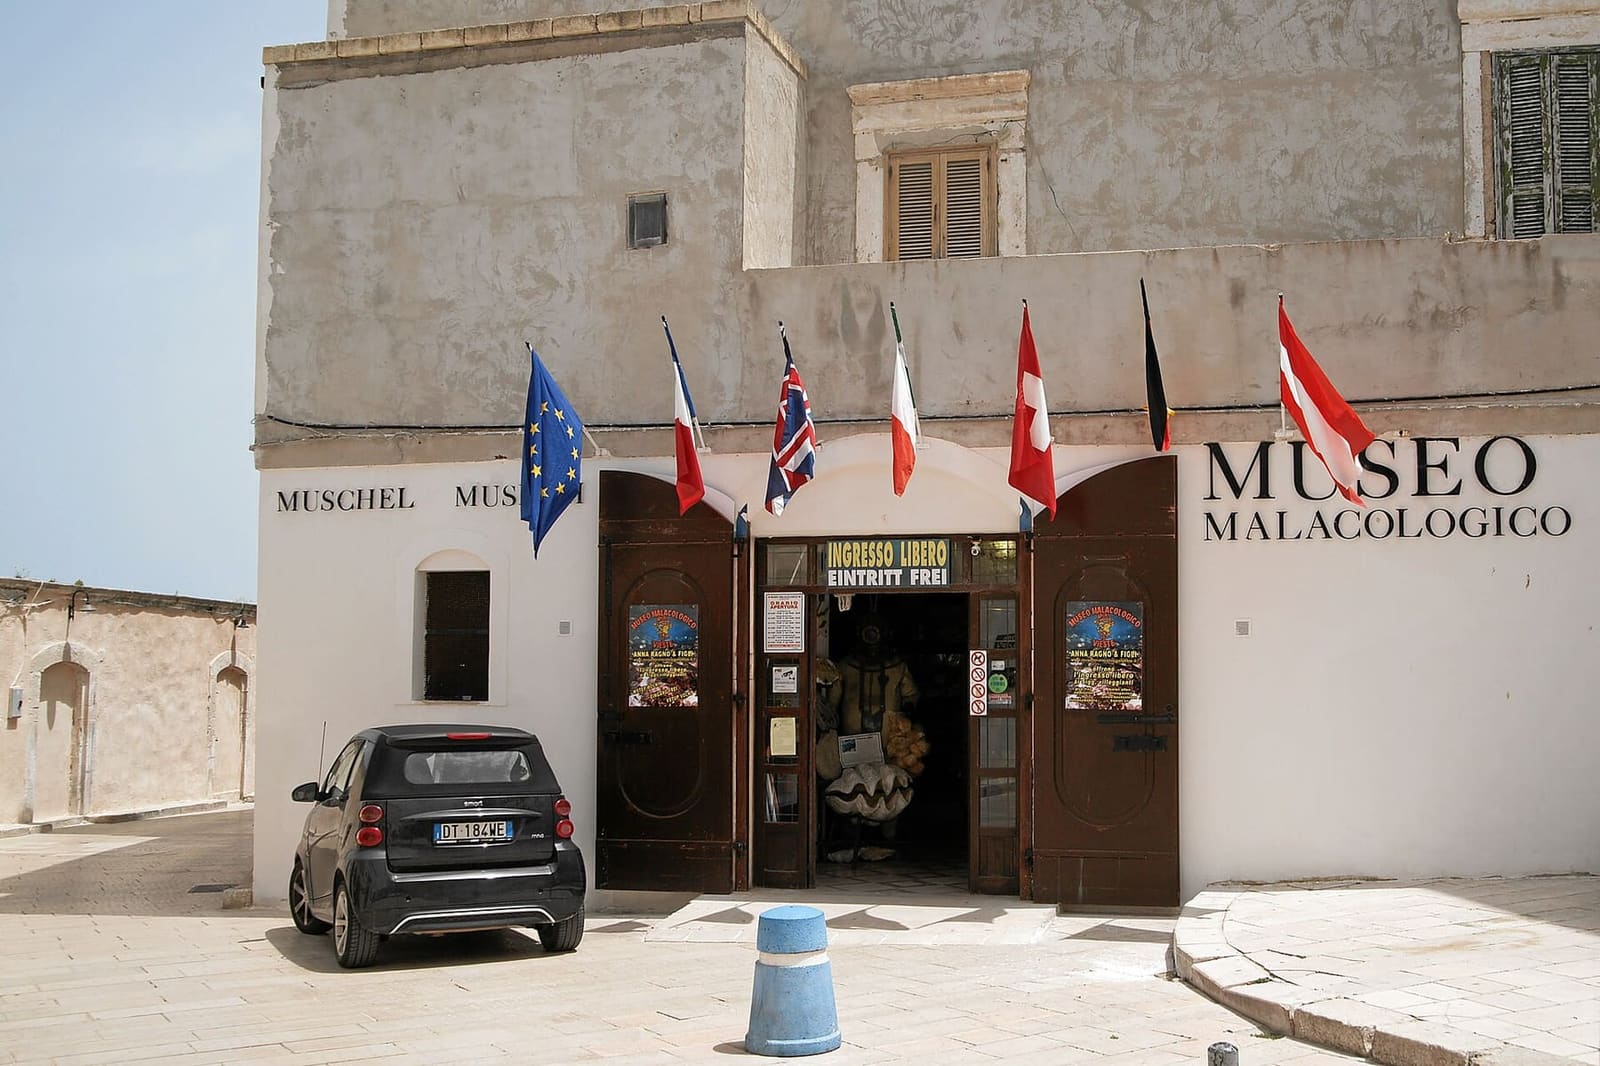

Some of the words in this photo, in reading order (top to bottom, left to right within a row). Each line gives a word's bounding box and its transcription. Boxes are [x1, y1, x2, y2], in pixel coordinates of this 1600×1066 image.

[1202, 435, 1537, 501] MUSEO
[276, 487, 415, 512] MUSCHEL
[1203, 506, 1572, 541] MALACOLOGICO
[828, 541, 894, 568] INGRESSO
[900, 540, 947, 567] LIBERO
[828, 569, 902, 586] EINTRITT
[910, 568, 947, 585] FREI
[631, 612, 652, 630] MUSEO
[651, 609, 697, 630] MALACOLOGICO
[1068, 609, 1092, 628] MUSEO
[1091, 606, 1141, 628] MALACOLOGICO
[1070, 649, 1088, 657] ANNA
[443, 824, 458, 839] DT
[465, 822, 505, 838] 184WE
